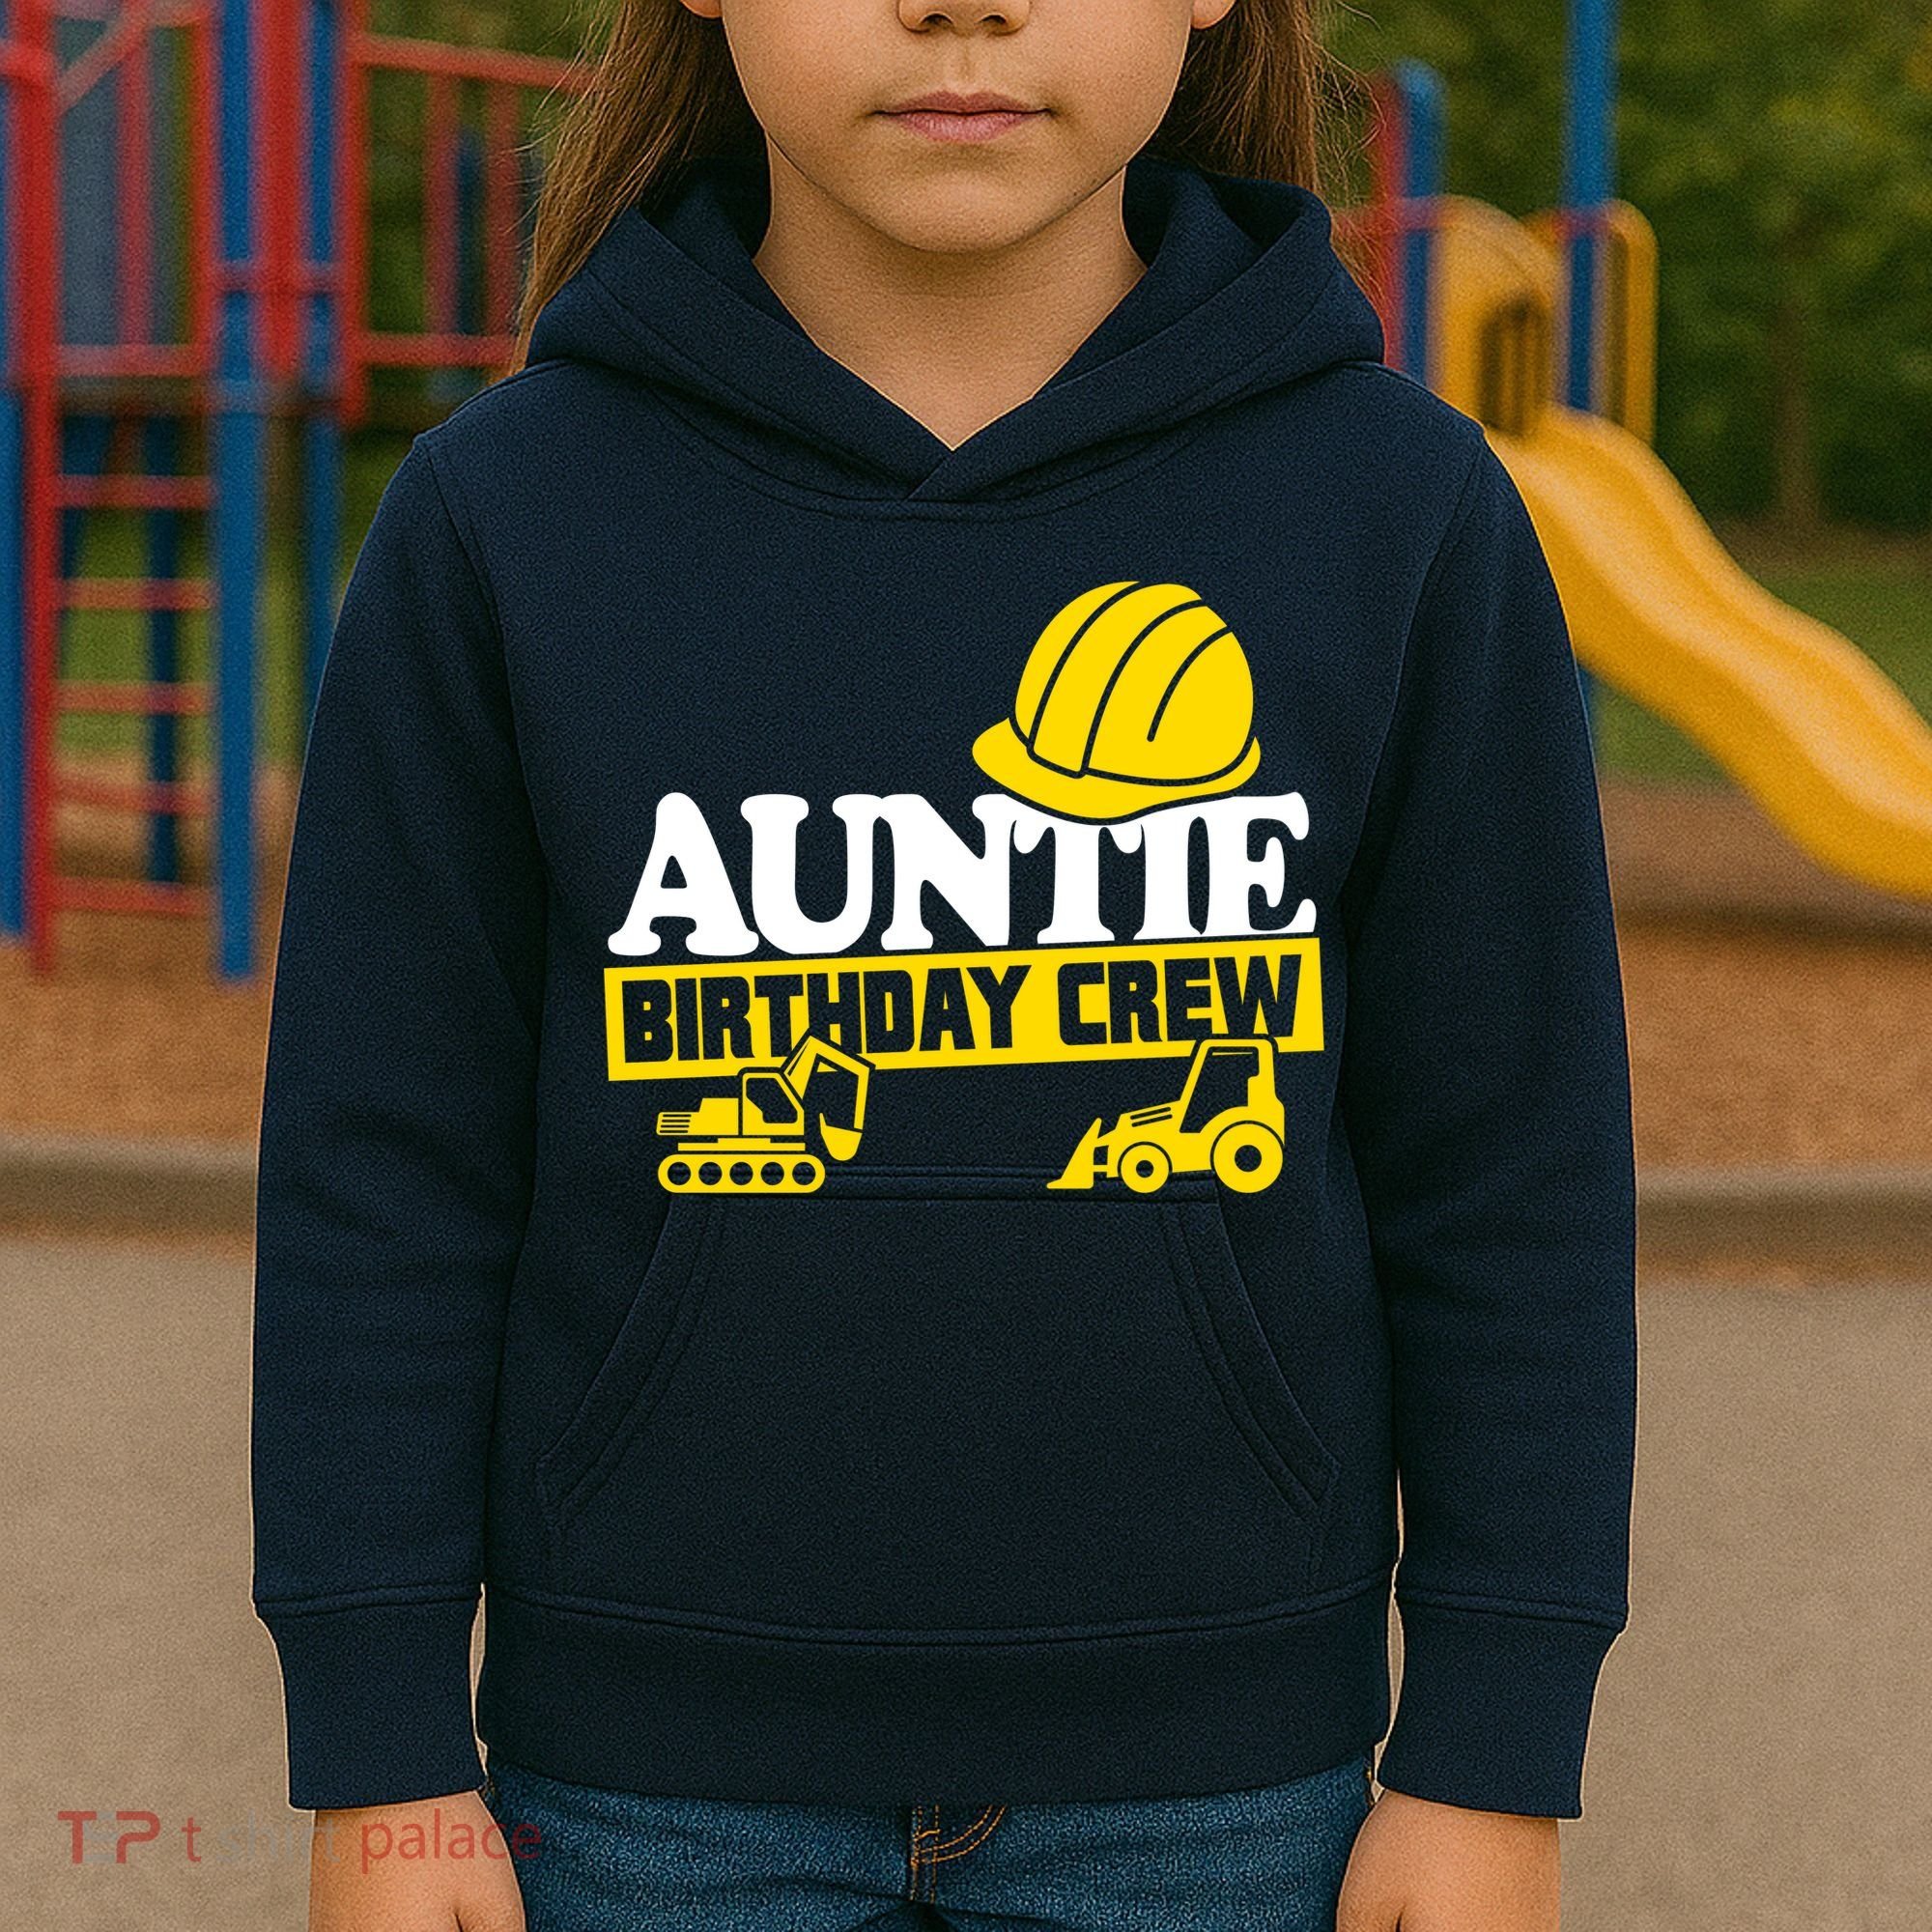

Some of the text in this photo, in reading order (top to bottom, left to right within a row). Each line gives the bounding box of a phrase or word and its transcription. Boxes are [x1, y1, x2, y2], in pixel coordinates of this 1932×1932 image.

[608, 791, 1317, 956] AUNTIE
[621, 953, 1302, 1064] BIRTHDAY CREW
